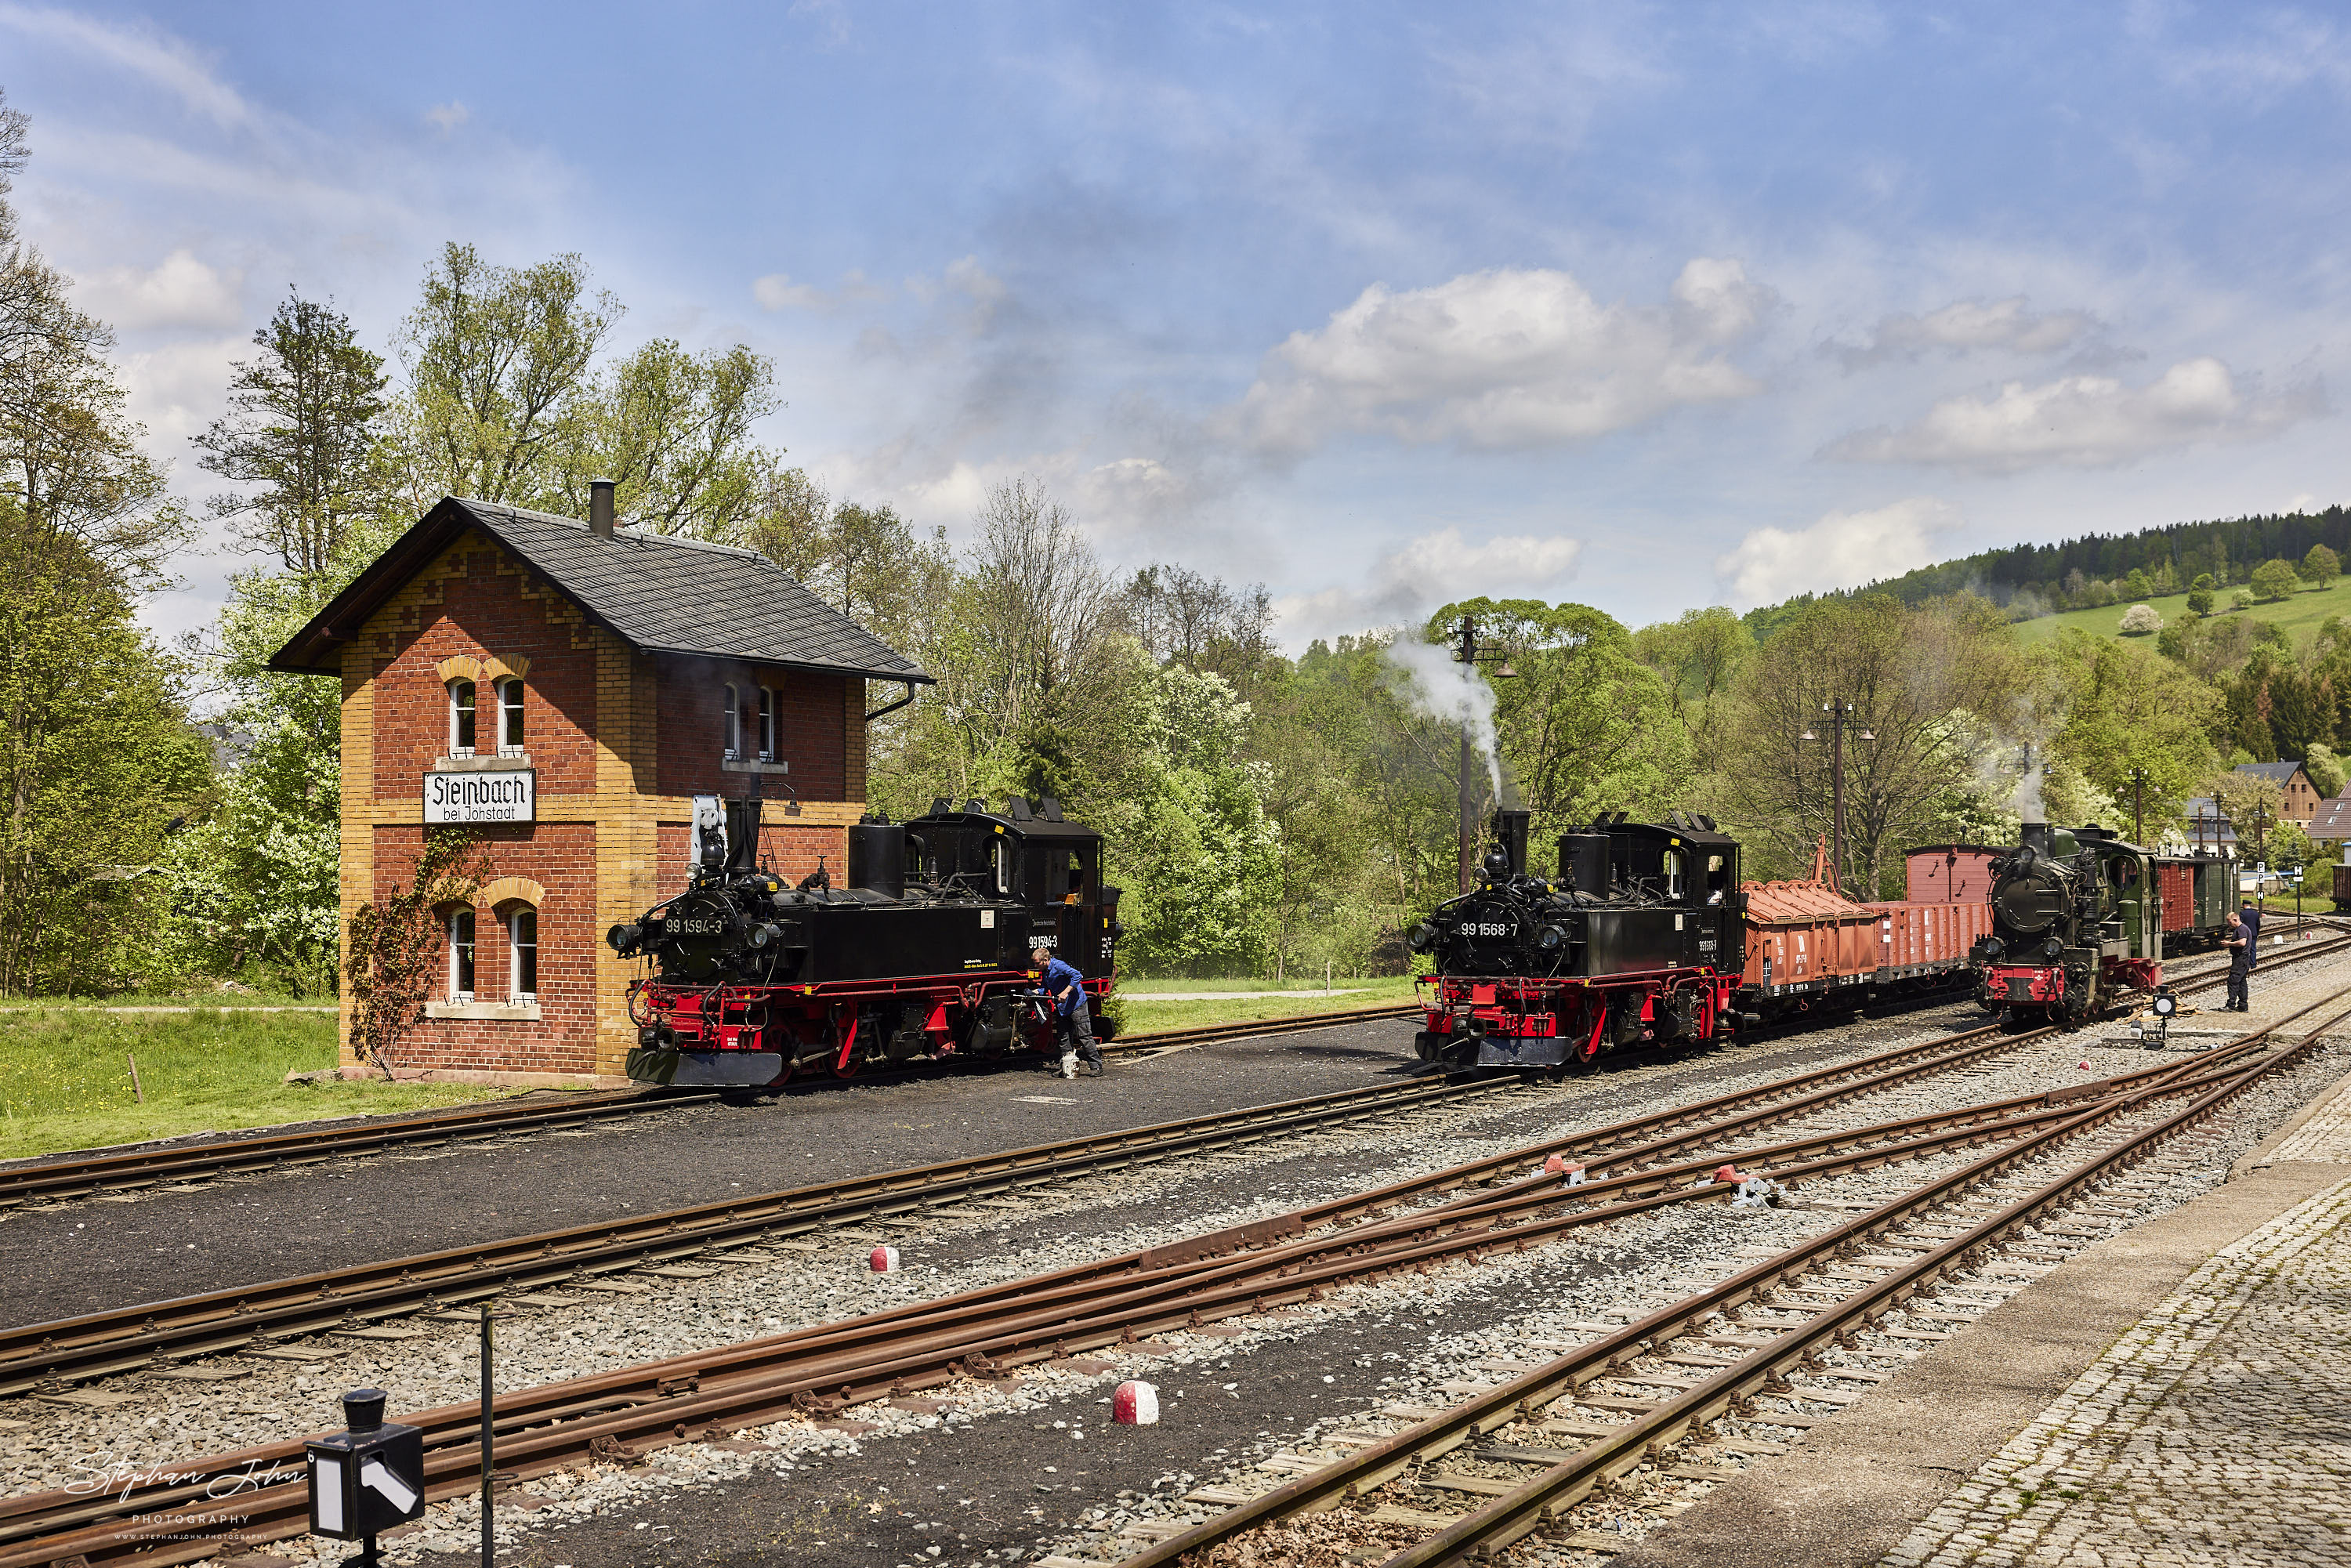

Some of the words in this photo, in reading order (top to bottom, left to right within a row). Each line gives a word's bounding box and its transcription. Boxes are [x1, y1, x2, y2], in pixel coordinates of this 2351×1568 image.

[433, 775, 525, 806] Steinbach
[444, 807, 461, 820] bei
[465, 806, 515, 820] Jöhstadt
[2294, 865, 2303, 876] H
[2259, 874, 2264, 882] P
[2257, 891, 2265, 900] H
[666, 918, 681, 933] 99
[683, 918, 722, 934] 1594-3
[1461, 922, 1476, 936] 99
[1478, 922, 1518, 936] 1568-7
[307, 1450, 315, 1464] 6
